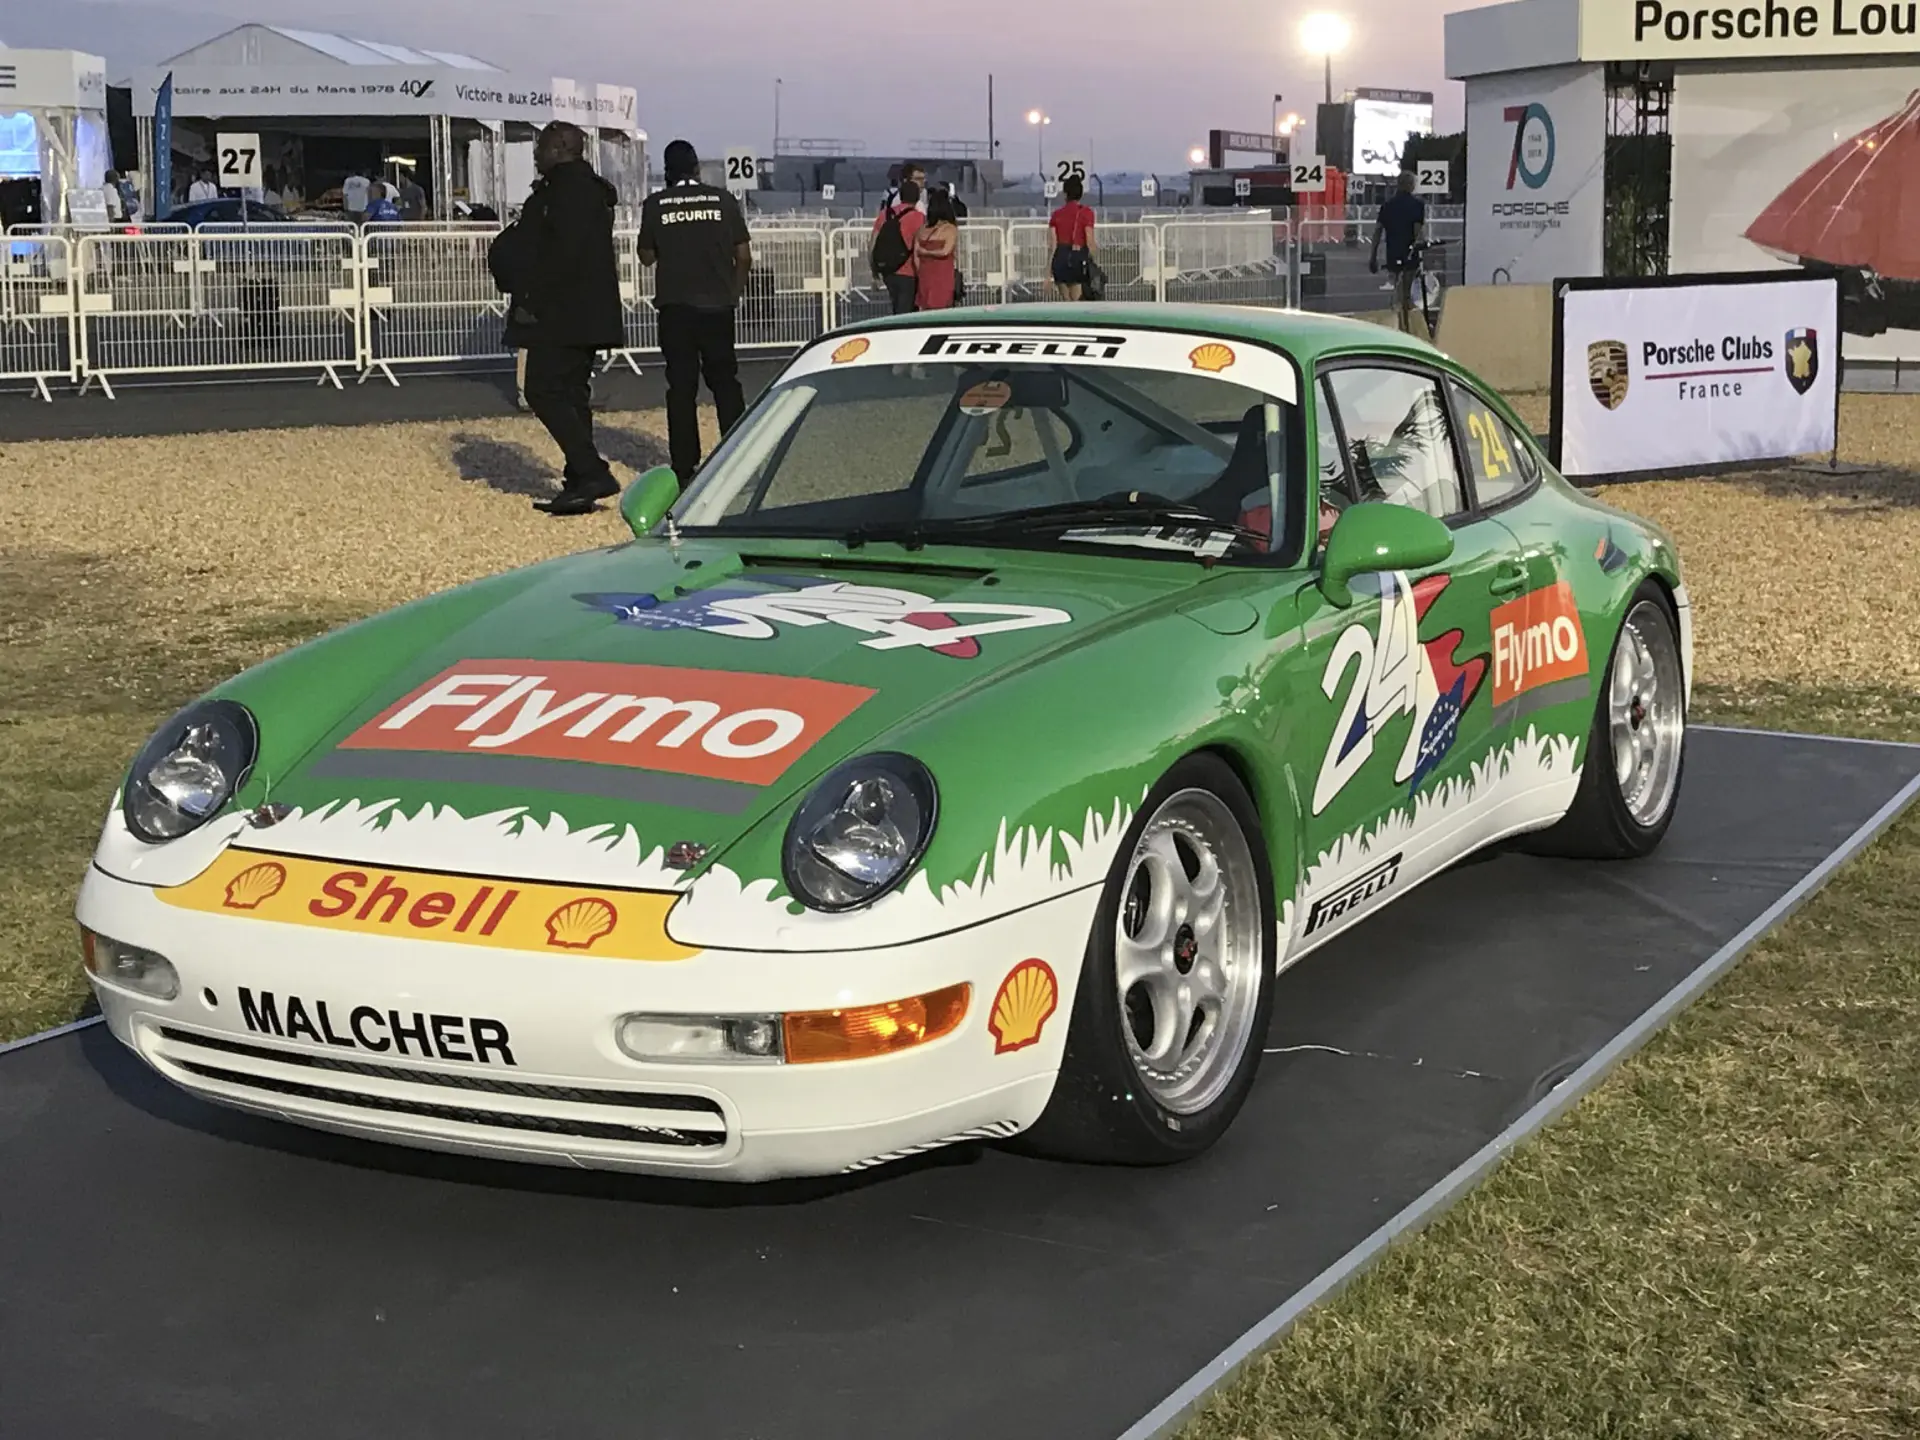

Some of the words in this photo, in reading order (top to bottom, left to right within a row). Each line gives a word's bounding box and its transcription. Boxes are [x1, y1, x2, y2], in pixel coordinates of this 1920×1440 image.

[1634, 0, 1818, 41] Porsche
[1832, 0, 1917, 36] Lou
[219, 86, 245, 95] aux
[250, 85, 281, 94] 24H
[289, 84, 309, 94] du
[317, 84, 356, 94] Mans
[361, 84, 395, 94] 1978
[455, 84, 503, 103] Victoire
[508, 91, 528, 105] aux
[530, 91, 552, 107] 24H
[221, 147, 256, 174] 27
[727, 155, 754, 180] 26
[1057, 160, 1085, 183] 25
[1294, 164, 1323, 183] 24
[1350, 179, 1363, 191] 16
[1420, 169, 1446, 186] 23
[661, 209, 722, 225] SECURITE
[1492, 200, 1569, 216] PORSCHE
[918, 333, 1127, 359] PIRELLI
[1643, 338, 1715, 366] Porsche
[1721, 335, 1773, 361] Clubs
[1679, 381, 1742, 400] France
[1468, 411, 1512, 480] 24
[1494, 615, 1580, 692] Flymo
[1312, 570, 1440, 817] 24
[379, 673, 806, 759] Flymo
[307, 870, 520, 937] Shell
[1302, 851, 1404, 938] PIRELLI
[238, 986, 518, 1066] MALCHER
